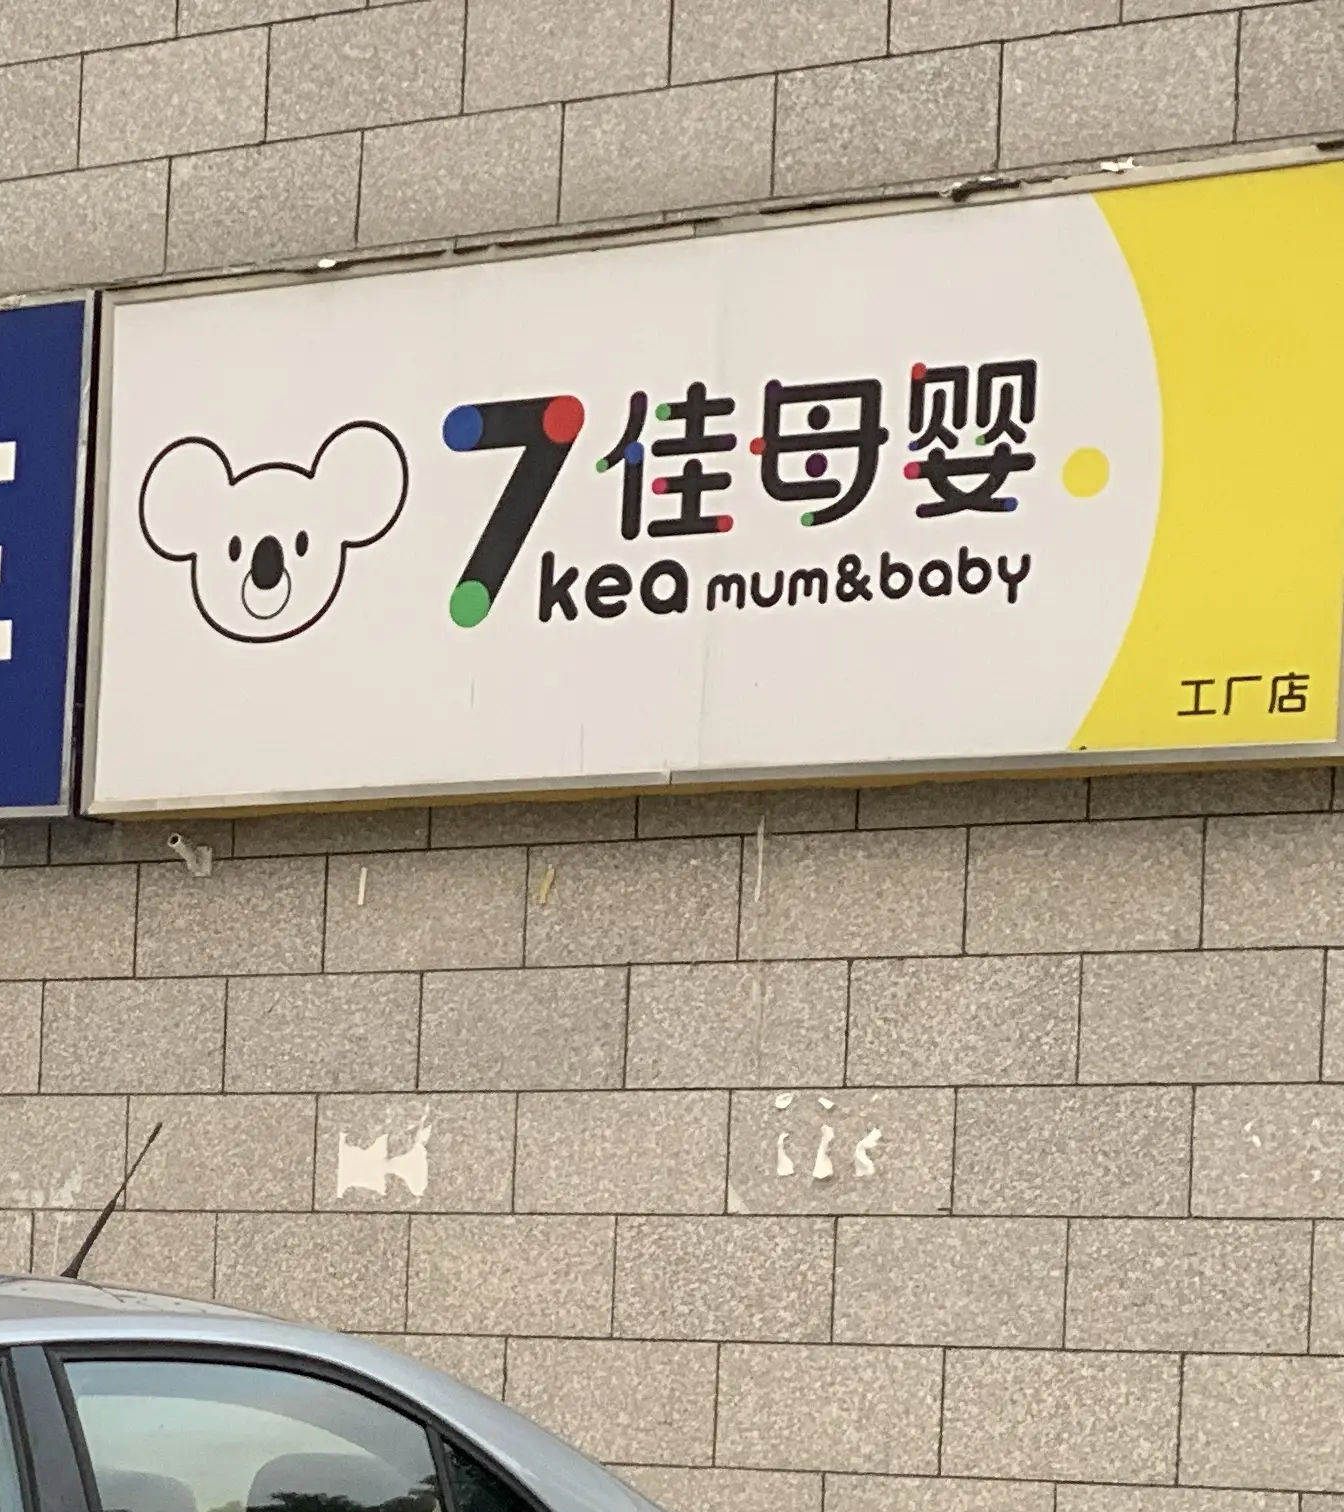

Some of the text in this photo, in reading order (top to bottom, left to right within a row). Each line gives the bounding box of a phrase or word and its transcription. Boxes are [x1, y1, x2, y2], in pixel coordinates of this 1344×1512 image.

[706, 545, 1031, 612] mum&baby
[1177, 672, 1310, 716] 工厂店
